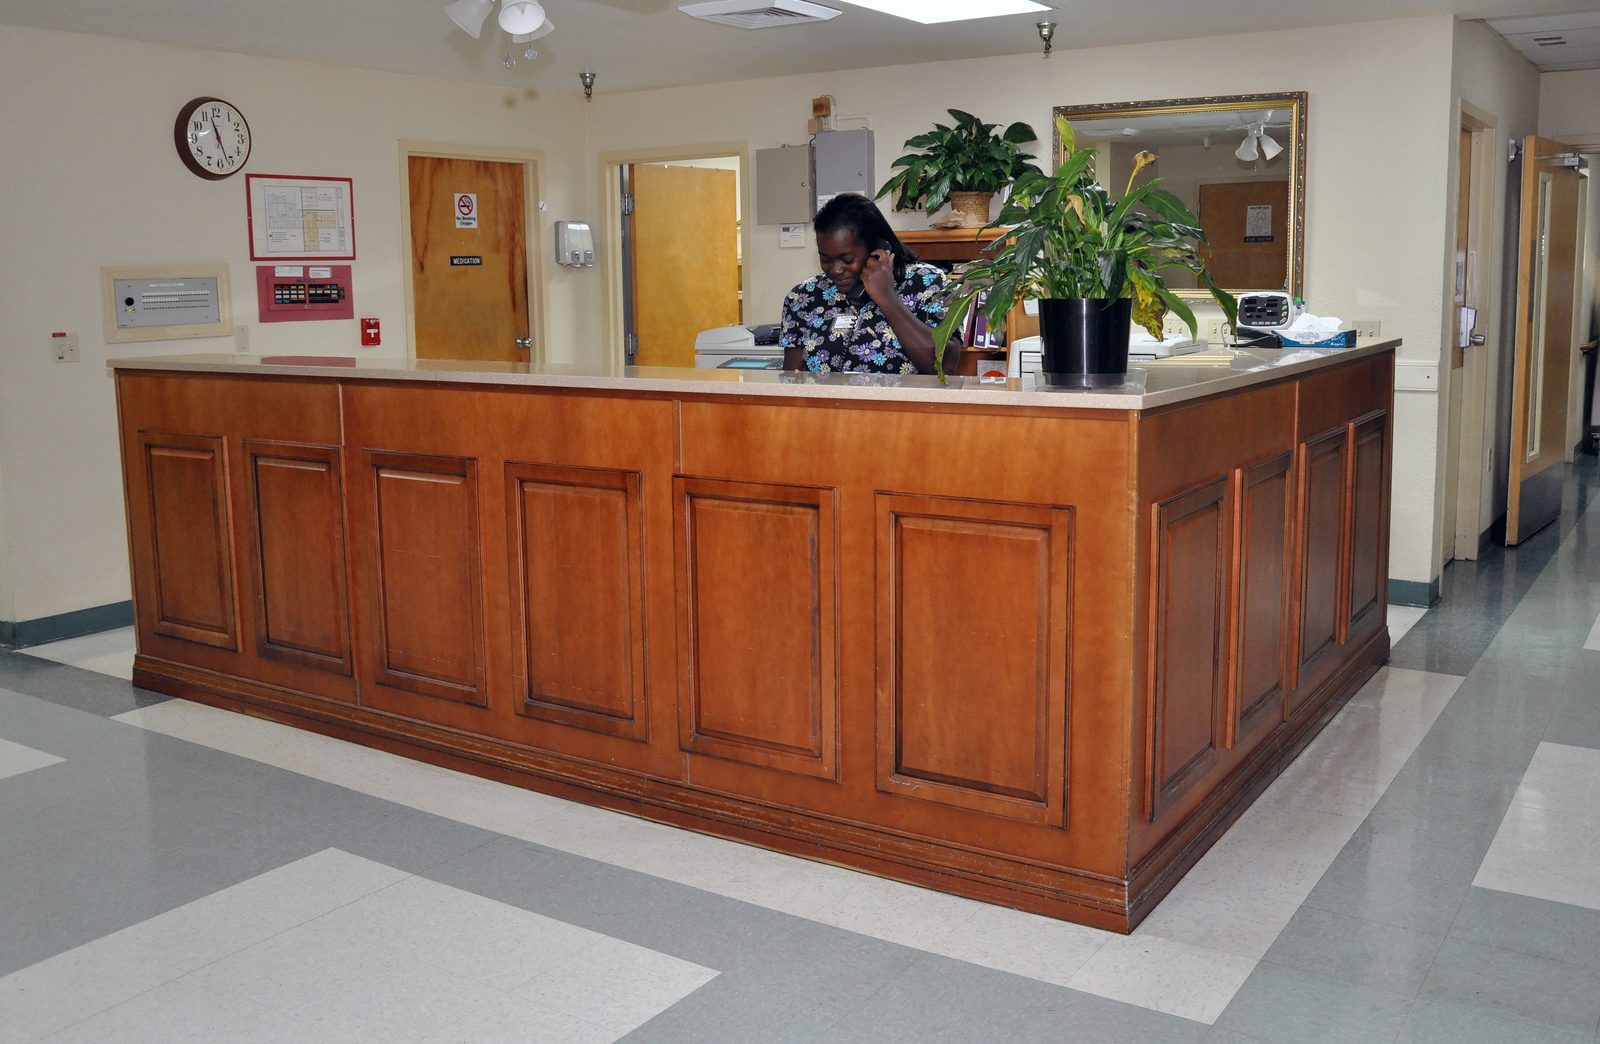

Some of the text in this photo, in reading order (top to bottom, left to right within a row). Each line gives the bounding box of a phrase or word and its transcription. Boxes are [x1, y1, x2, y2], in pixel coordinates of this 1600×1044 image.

[202, 111, 208, 122] 11
[212, 107, 220, 118] 12
[227, 112, 230, 122] 1
[192, 120, 202, 131] 10
[234, 122, 240, 132] 2
[191, 133, 198, 144] 9
[238, 134, 244, 144] 3
[196, 146, 204, 156] 8
[234, 146, 241, 156] 4
[206, 156, 212, 166] 7
[217, 158, 224, 169] 6
[228, 156, 234, 166] 5
